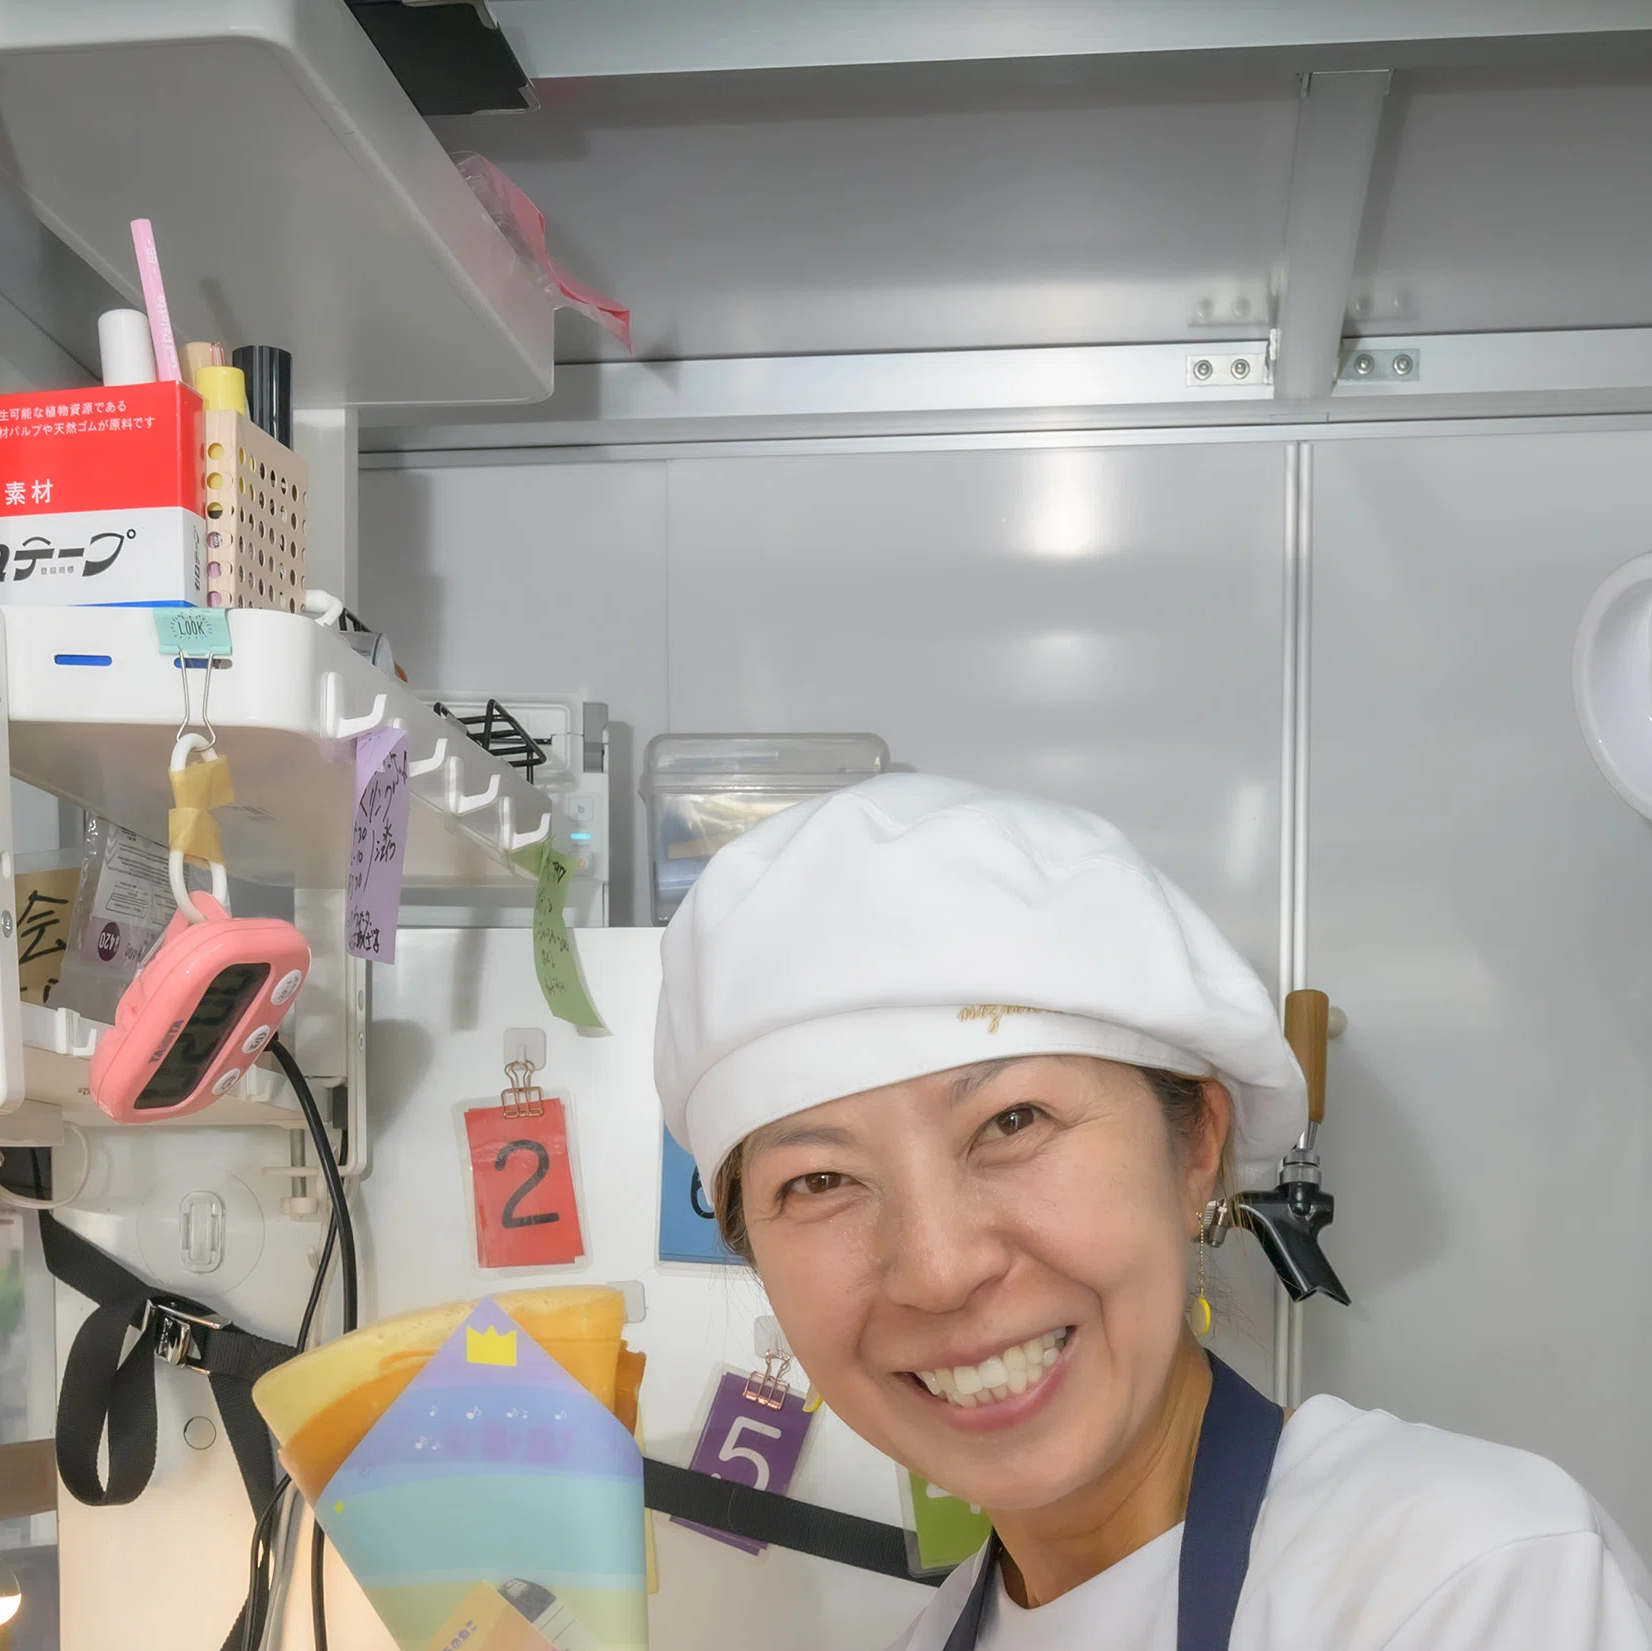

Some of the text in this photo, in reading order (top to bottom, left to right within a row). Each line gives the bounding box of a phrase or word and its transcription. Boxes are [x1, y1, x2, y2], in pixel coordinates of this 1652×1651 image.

[178, 620, 205, 636] LOOK
[494, 1139, 560, 1229] 2
[710, 1415, 782, 1491] 5
